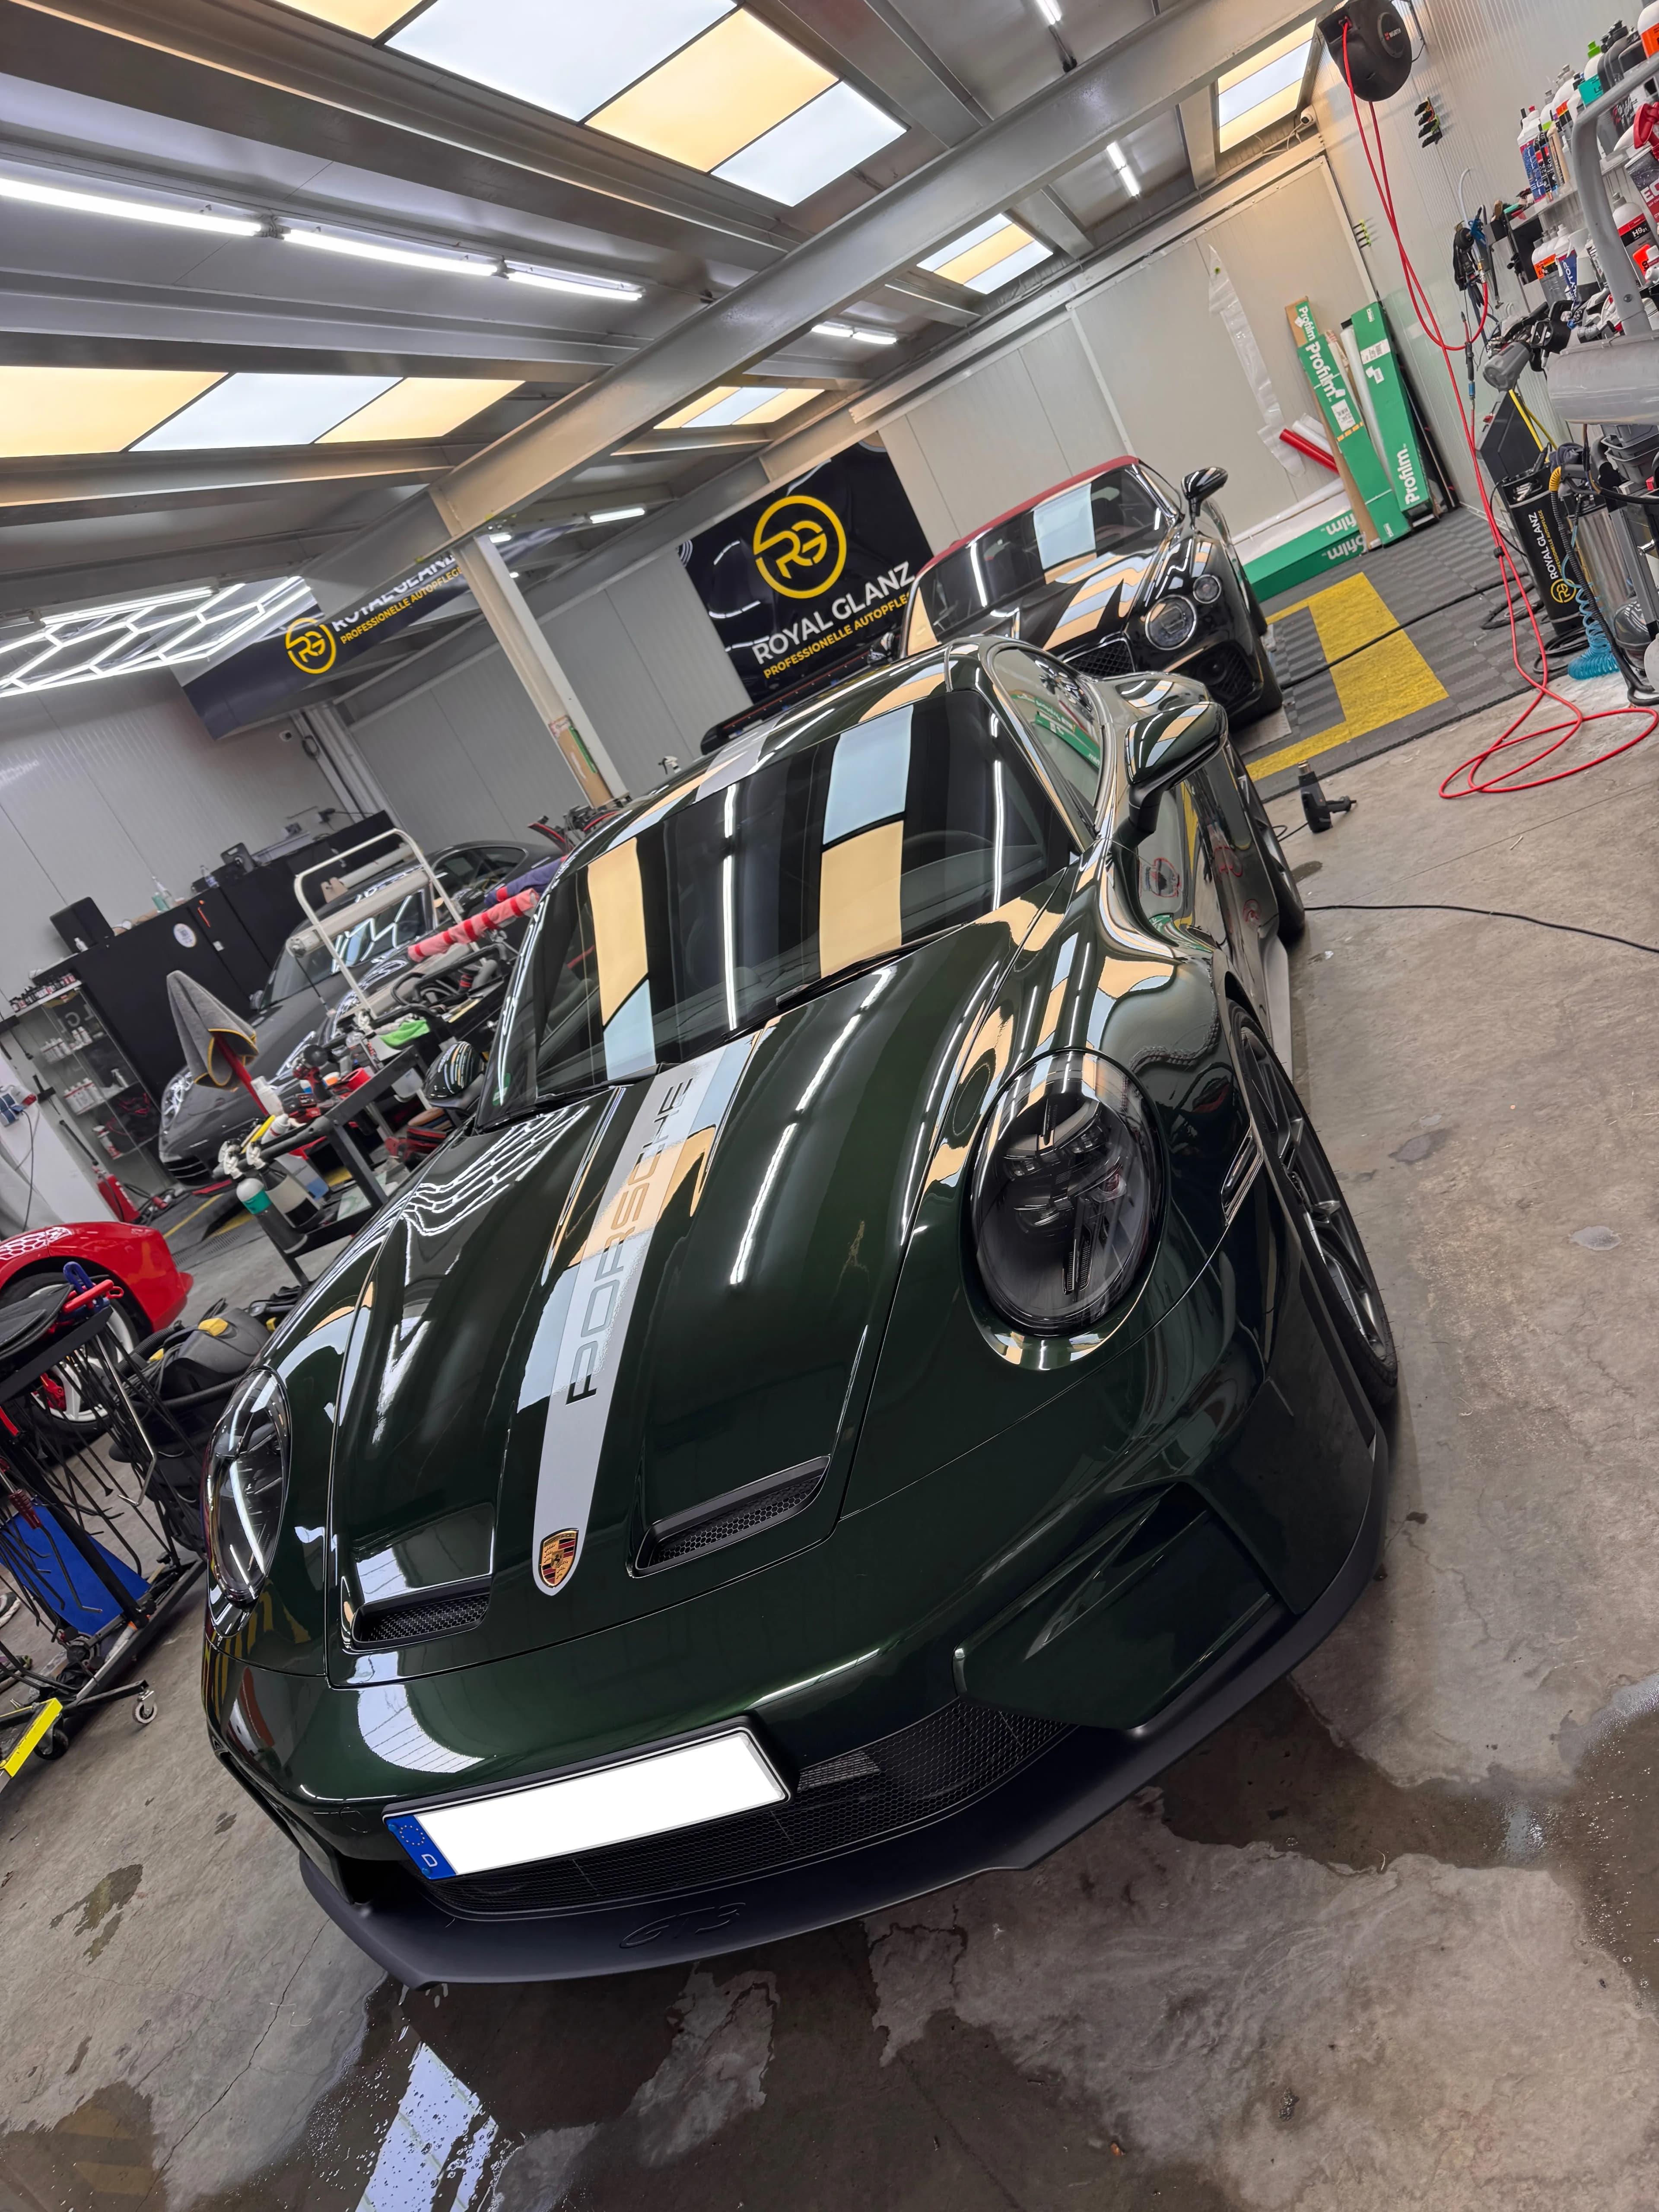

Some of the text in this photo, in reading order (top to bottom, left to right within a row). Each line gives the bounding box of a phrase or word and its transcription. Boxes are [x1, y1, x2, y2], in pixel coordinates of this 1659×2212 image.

[1299, 305, 1316, 341] Profilm
[1305, 341, 1337, 398] Profilm
[1397, 448, 1420, 505] Profilm
[1325, 513, 1357, 535] film
[1528, 512, 1558, 580] ROYAL GLANZ
[340, 566, 463, 645] PROFESSIONELLE AUTOPFLEGE
[752, 561, 916, 664] ROYAL GLANZ
[763, 591, 910, 679] PROFESSIONELLE AUTOPFLE
[566, 1078, 693, 1405] PORSCHE
[421, 1853, 438, 1868] D
[619, 1902, 746, 1949] GT3
